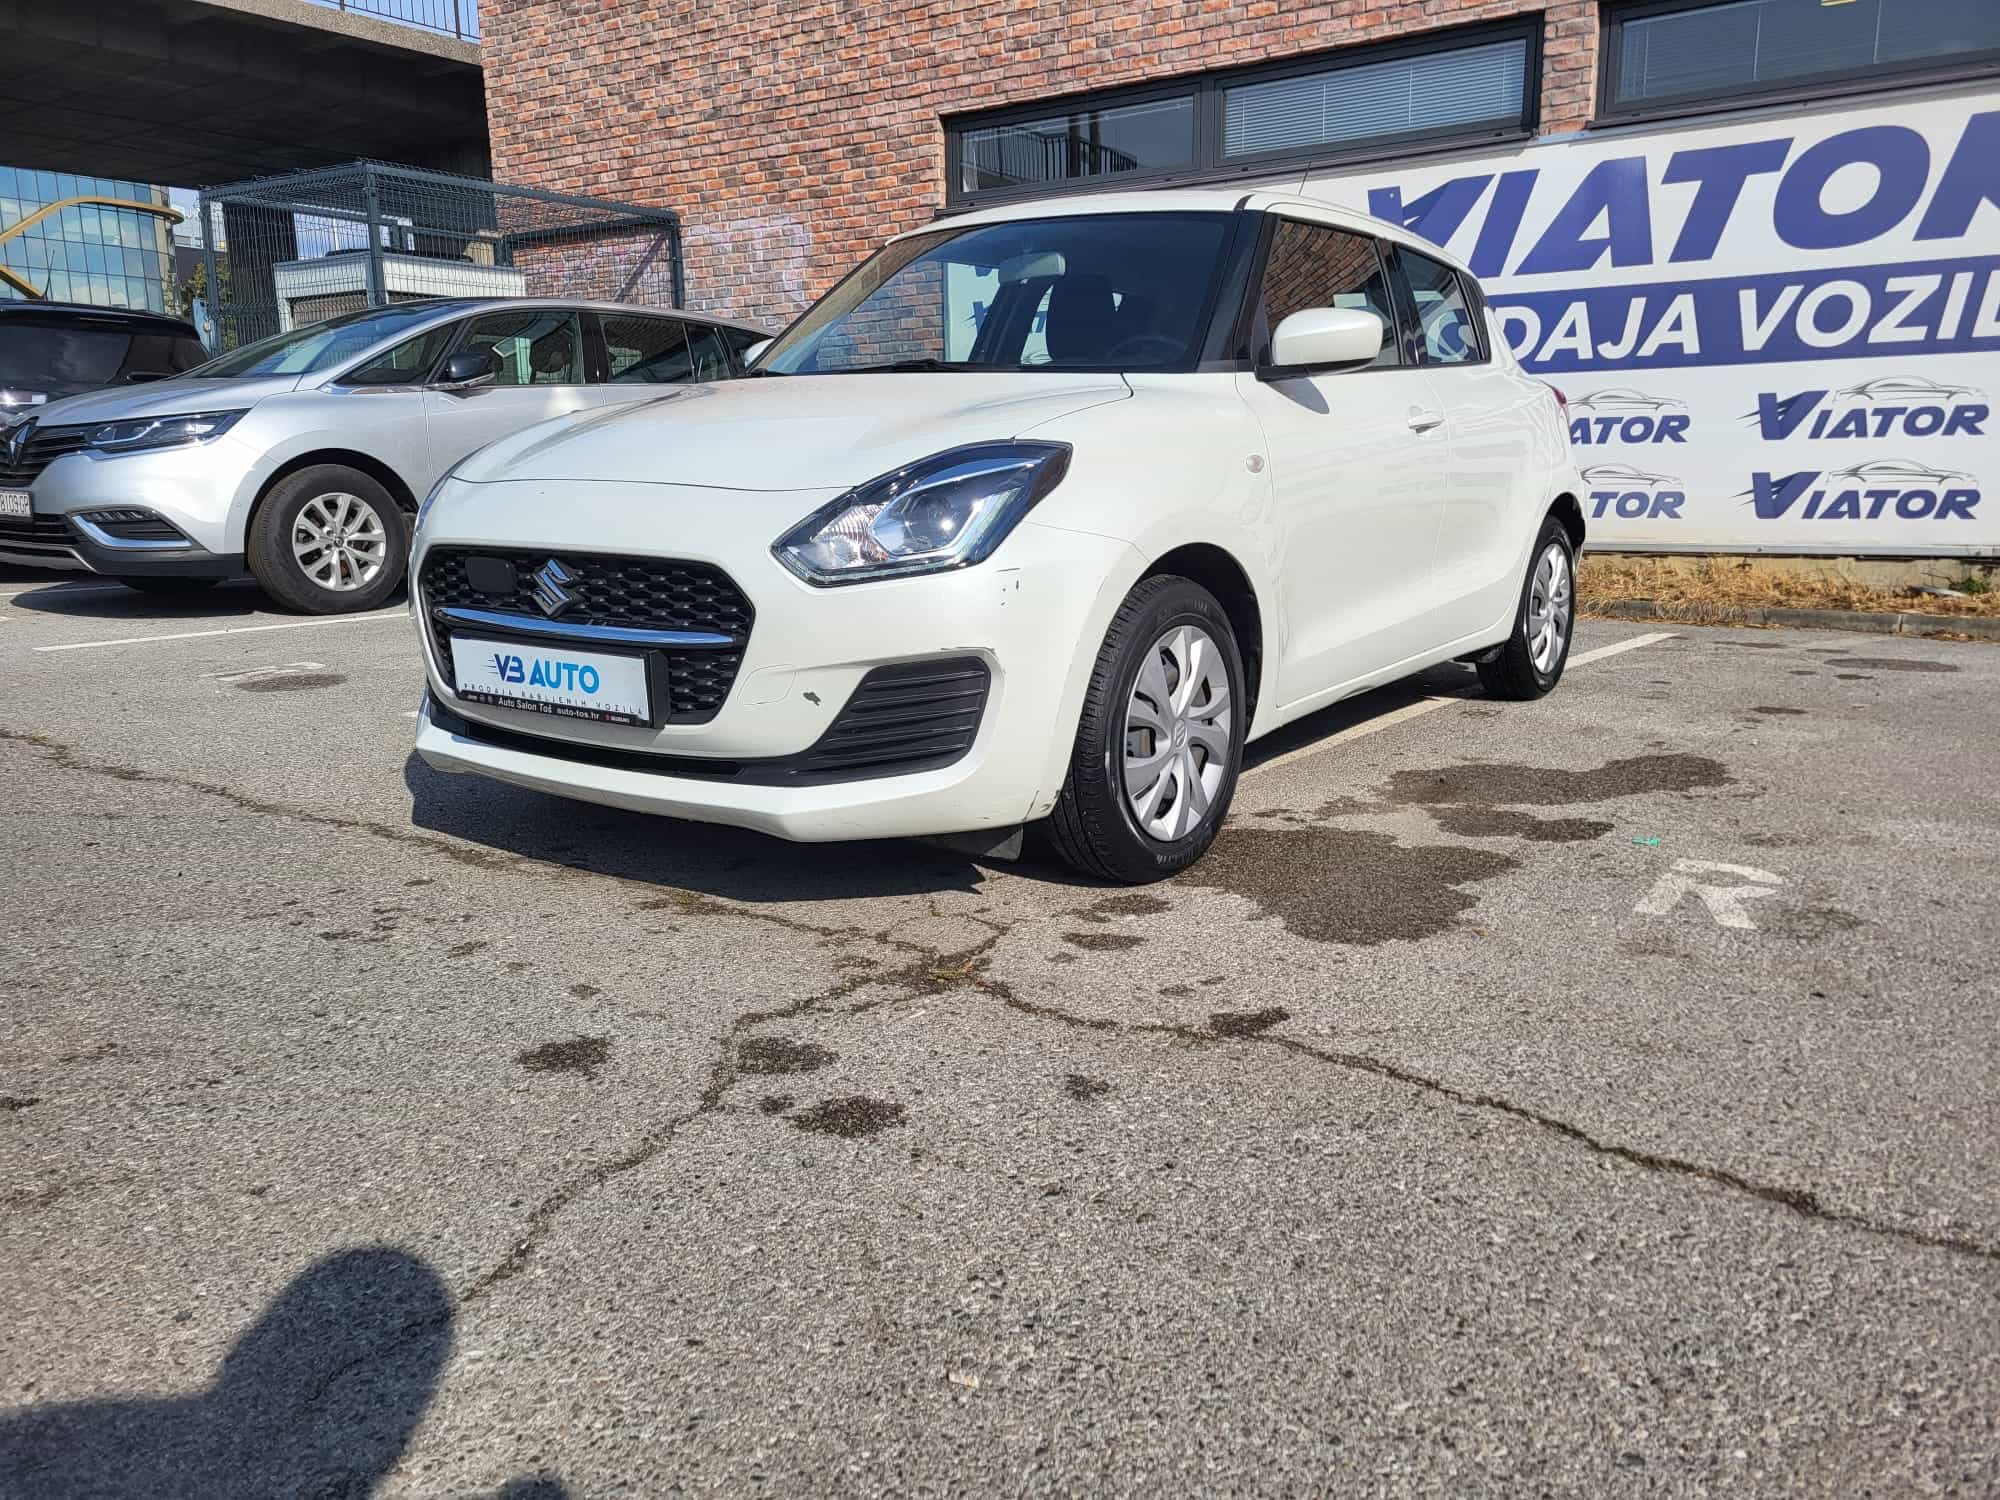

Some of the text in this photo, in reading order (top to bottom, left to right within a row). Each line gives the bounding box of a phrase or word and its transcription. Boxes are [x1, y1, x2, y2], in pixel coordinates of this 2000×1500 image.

[1496, 293, 1700, 361] DAJA
[1570, 414, 1691, 444] ATOR
[1757, 390, 1990, 440] VIATOR
[1589, 491, 1685, 519] TOR
[1751, 471, 1981, 519] VIATOR
[529, 659, 600, 695] AUTO
[498, 697, 515, 708] Auto
[516, 700, 537, 712] Salon
